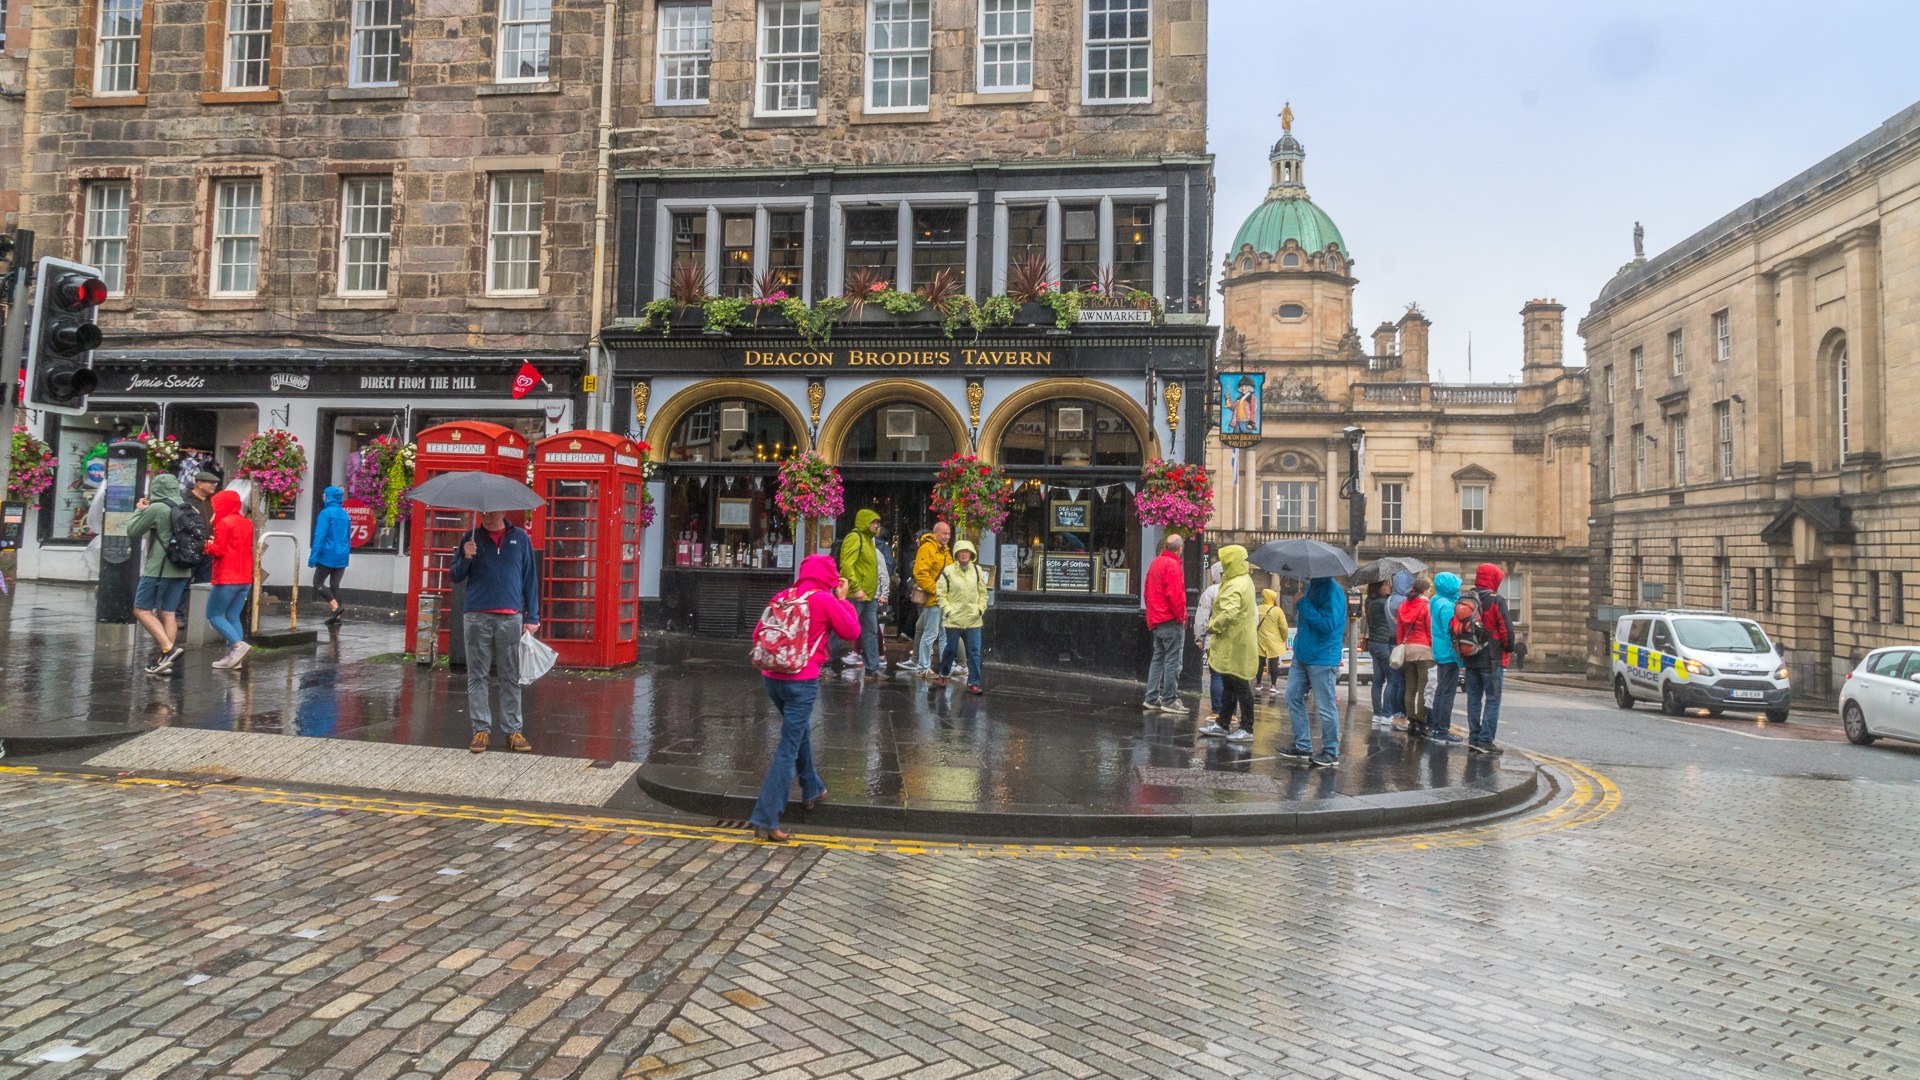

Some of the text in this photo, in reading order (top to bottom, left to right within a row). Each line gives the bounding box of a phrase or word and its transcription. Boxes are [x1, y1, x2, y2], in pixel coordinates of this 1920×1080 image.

[1092, 298, 1126, 308] ROYAL
[1080, 311, 1148, 321] AWNMARKET
[744, 350, 1052, 366] DEACON BRODIE'S TAVERN
[126, 374, 163, 392] Jamie
[271, 373, 308, 389] MILLSHOP
[360, 376, 476, 390] DIRECT FROM THE MILL
[430, 444, 484, 452] TELEPHONE
[548, 454, 602, 462] TELEPHONE
[350, 526, 368, 540] 75
[1627, 666, 1659, 682] POLICE
